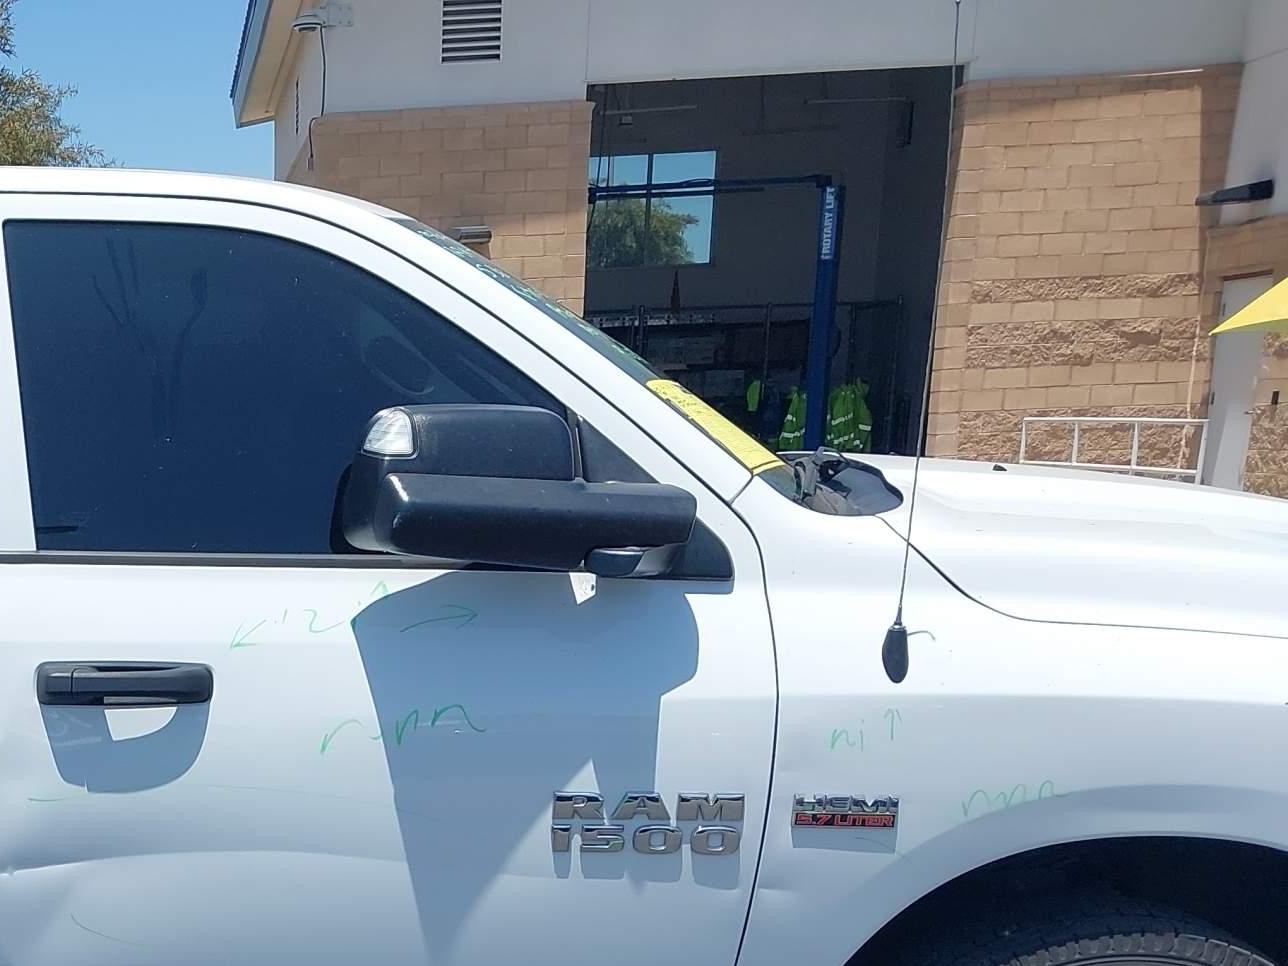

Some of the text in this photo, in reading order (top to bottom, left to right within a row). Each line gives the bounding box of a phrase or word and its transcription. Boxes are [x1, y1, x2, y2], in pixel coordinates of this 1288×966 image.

[821, 186, 835, 254] ROTARY LIFT
[552, 790, 746, 821] RAM
[793, 793, 900, 813] HEMI
[796, 813, 894, 827] 5.7 LITER
[551, 825, 743, 855] 1500
